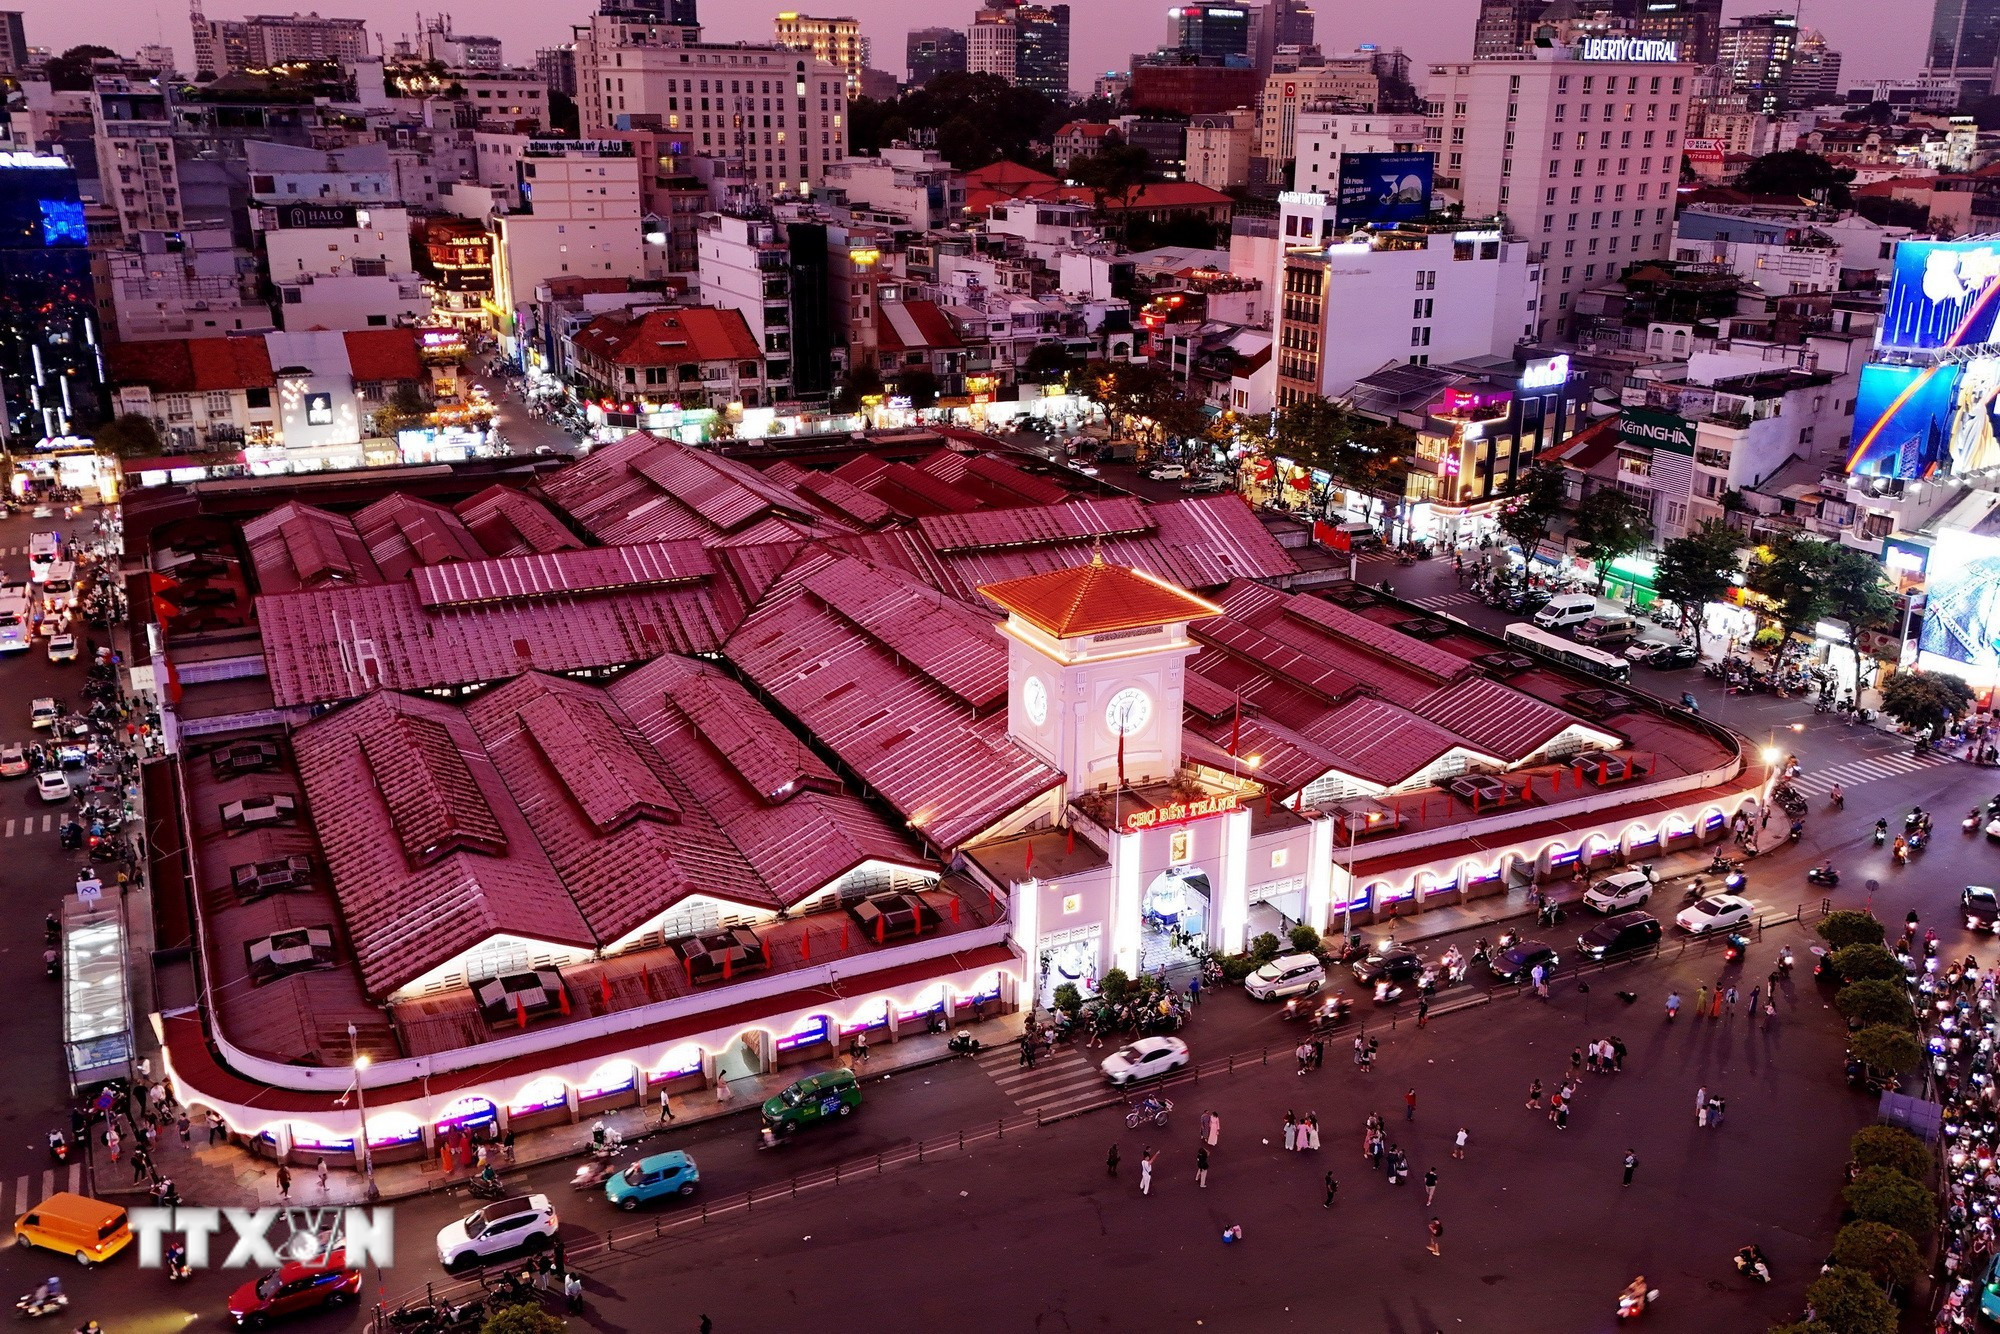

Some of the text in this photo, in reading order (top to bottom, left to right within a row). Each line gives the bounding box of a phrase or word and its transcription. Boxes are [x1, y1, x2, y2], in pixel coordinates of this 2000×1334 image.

[1584, 38, 1677, 61] LIBERTY CENTRAL
[308, 210, 343, 220] HALO
[1127, 795, 1237, 827] CHỢ BẾN THÀNH
